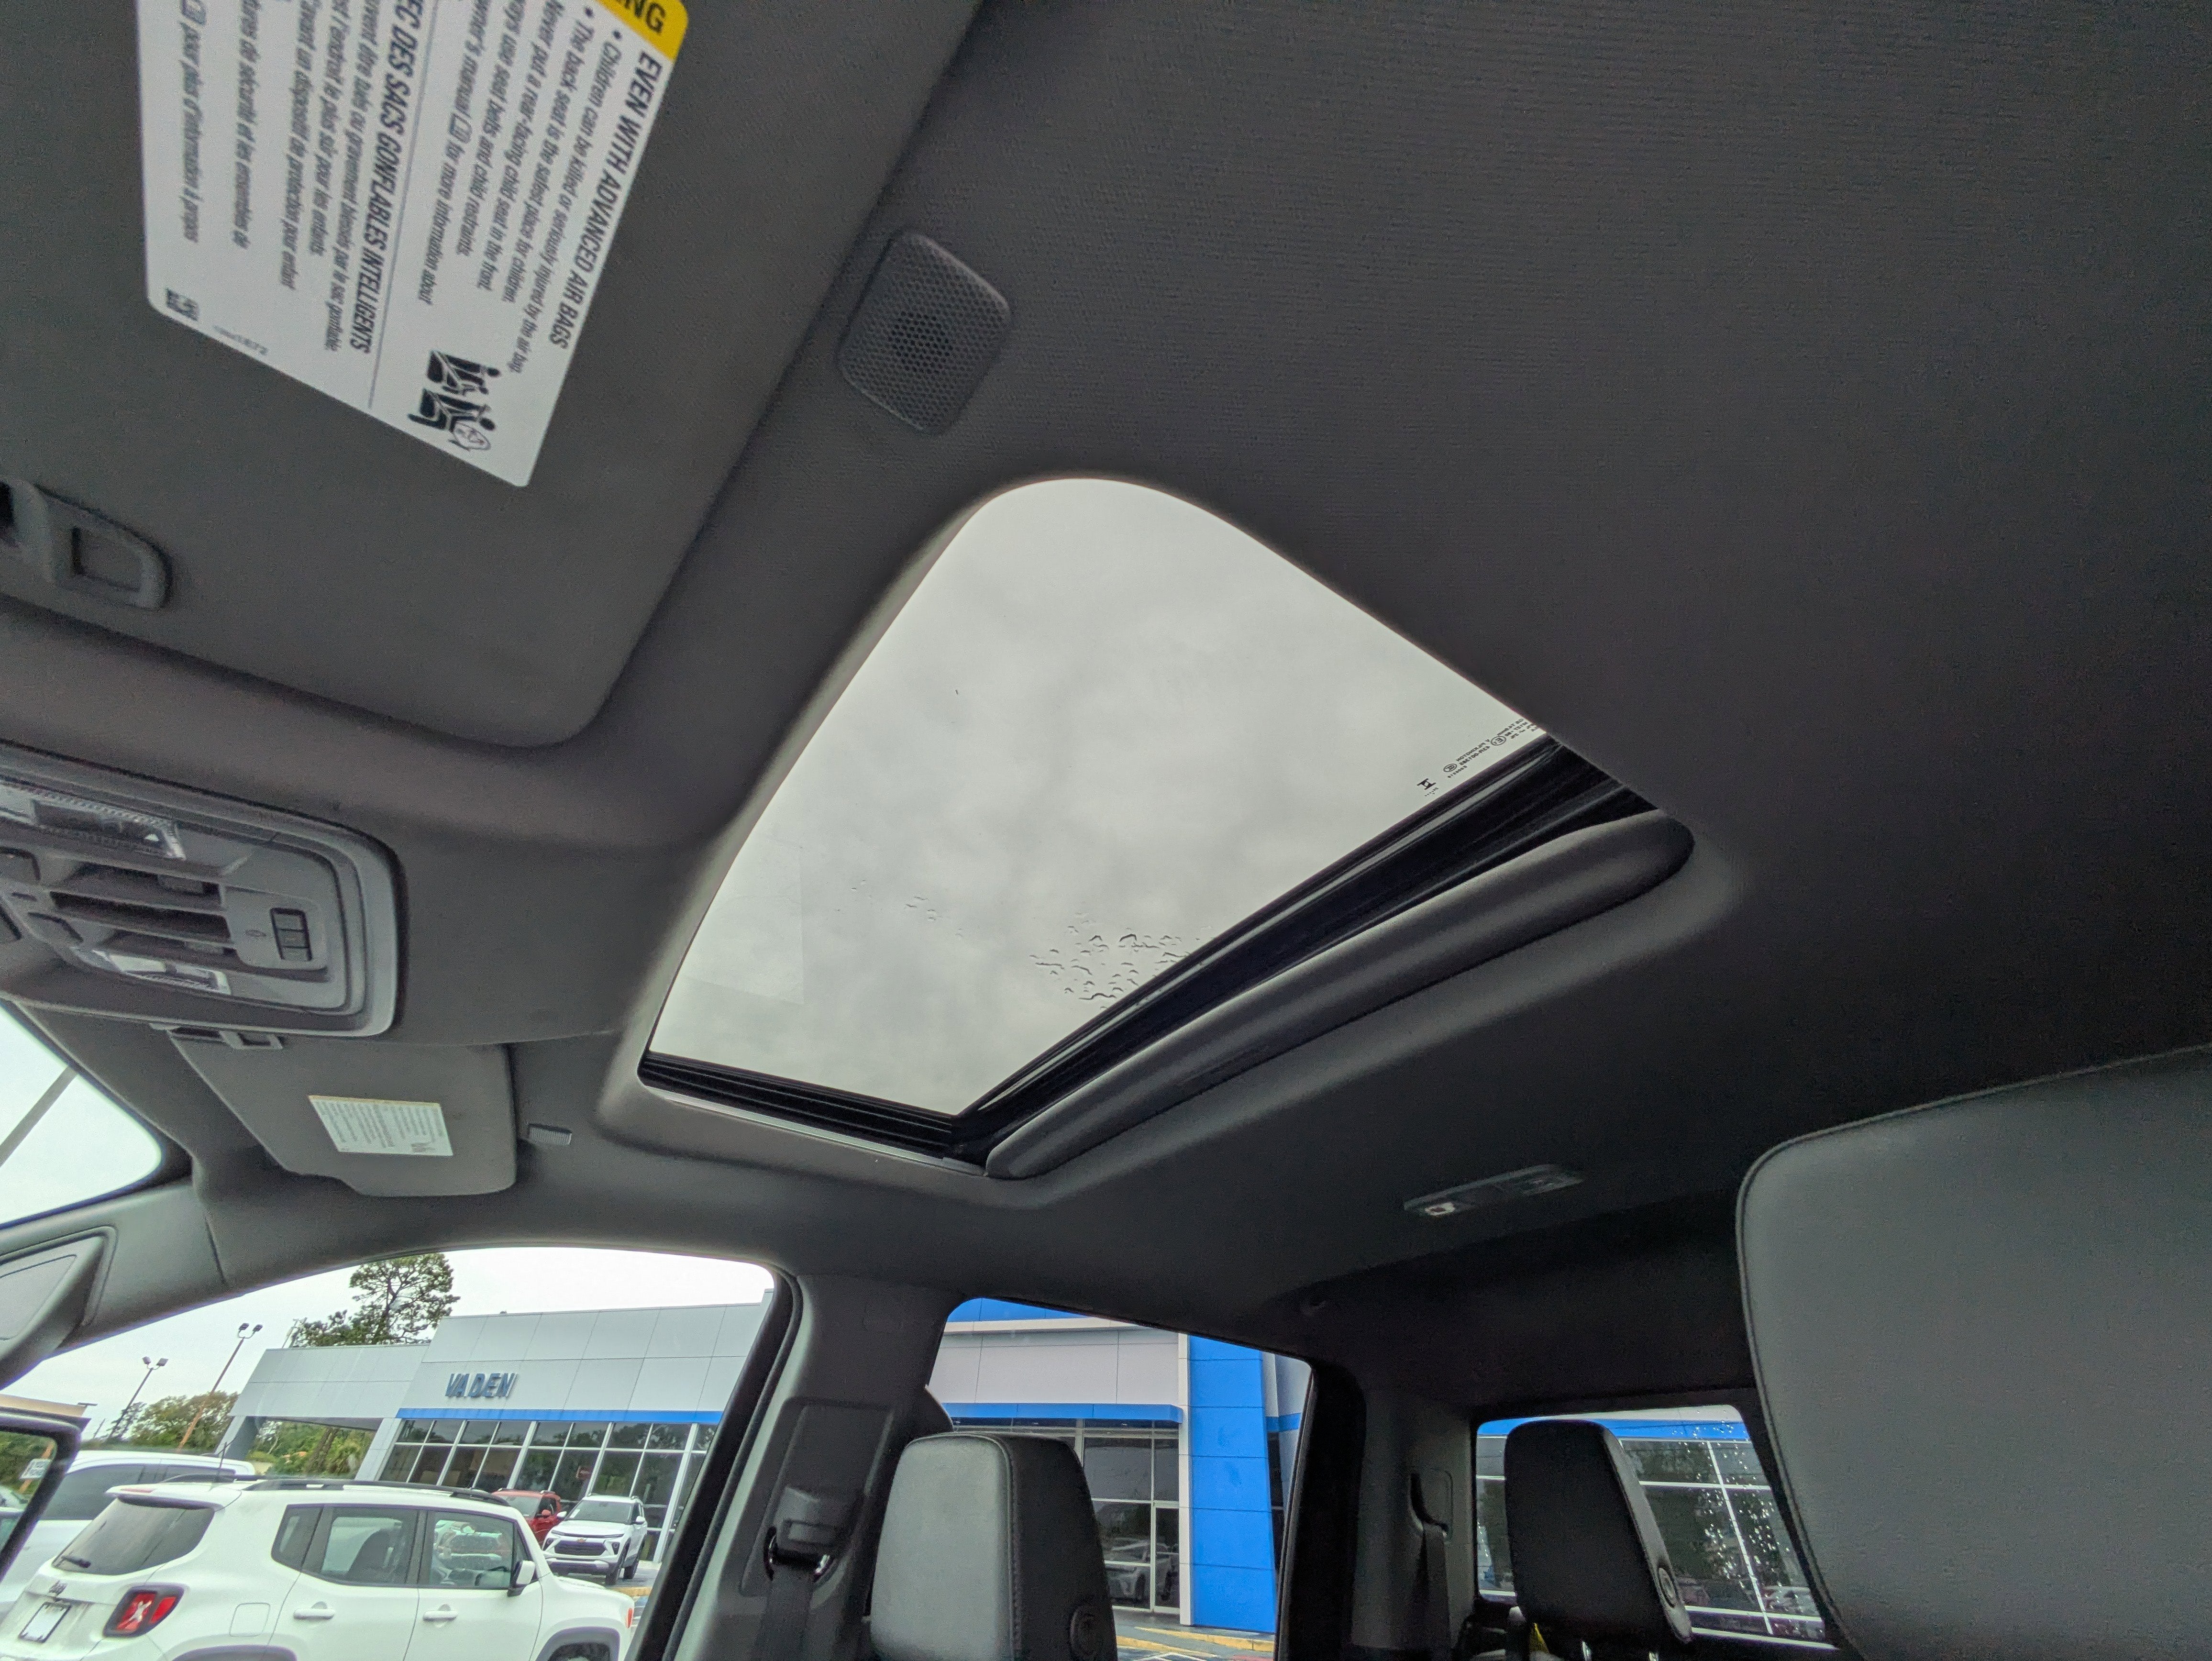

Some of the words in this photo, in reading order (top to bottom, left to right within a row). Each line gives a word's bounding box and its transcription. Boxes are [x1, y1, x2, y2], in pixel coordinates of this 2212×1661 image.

[387, 23, 419, 78] DES
[570, 20, 595, 53] The
[529, 42, 549, 78] put
[559, 50, 585, 93] back
[588, 41, 622, 108] Children
[526, 73, 542, 89] a
[624, 50, 663, 118] EVEN
[379, 72, 411, 136] SACS
[550, 89, 571, 128] seat
[579, 106, 598, 137] can
[504, 86, 538, 167] rear-facing
[546, 123, 564, 141] is
[605, 114, 641, 175] WITH
[539, 139, 560, 165] the
[573, 134, 593, 157] be
[363, 131, 402, 251] GONFLABLES
[498, 165, 520, 202] child
[528, 162, 551, 207] safest
[562, 155, 587, 198] killed
[492, 197, 511, 230] seat
[519, 200, 541, 240] place
[558, 193, 572, 212] or
[573, 168, 621, 273] ADVANCED
[484, 240, 503, 263] the
[489, 226, 506, 242] in
[514, 238, 533, 259] for
[539, 209, 568, 266] seriously
[476, 261, 498, 291] front.
[501, 256, 526, 303] children.
[530, 264, 554, 307] injured
[563, 269, 587, 305] AIR
[349, 246, 385, 354] INTELLIGENTS
[523, 303, 542, 321] by
[520, 319, 538, 338] the
[549, 301, 578, 349] BAGS
[507, 352, 528, 373] bag.
[516, 336, 531, 354] air
[445, 1373, 517, 1397] VADEN
